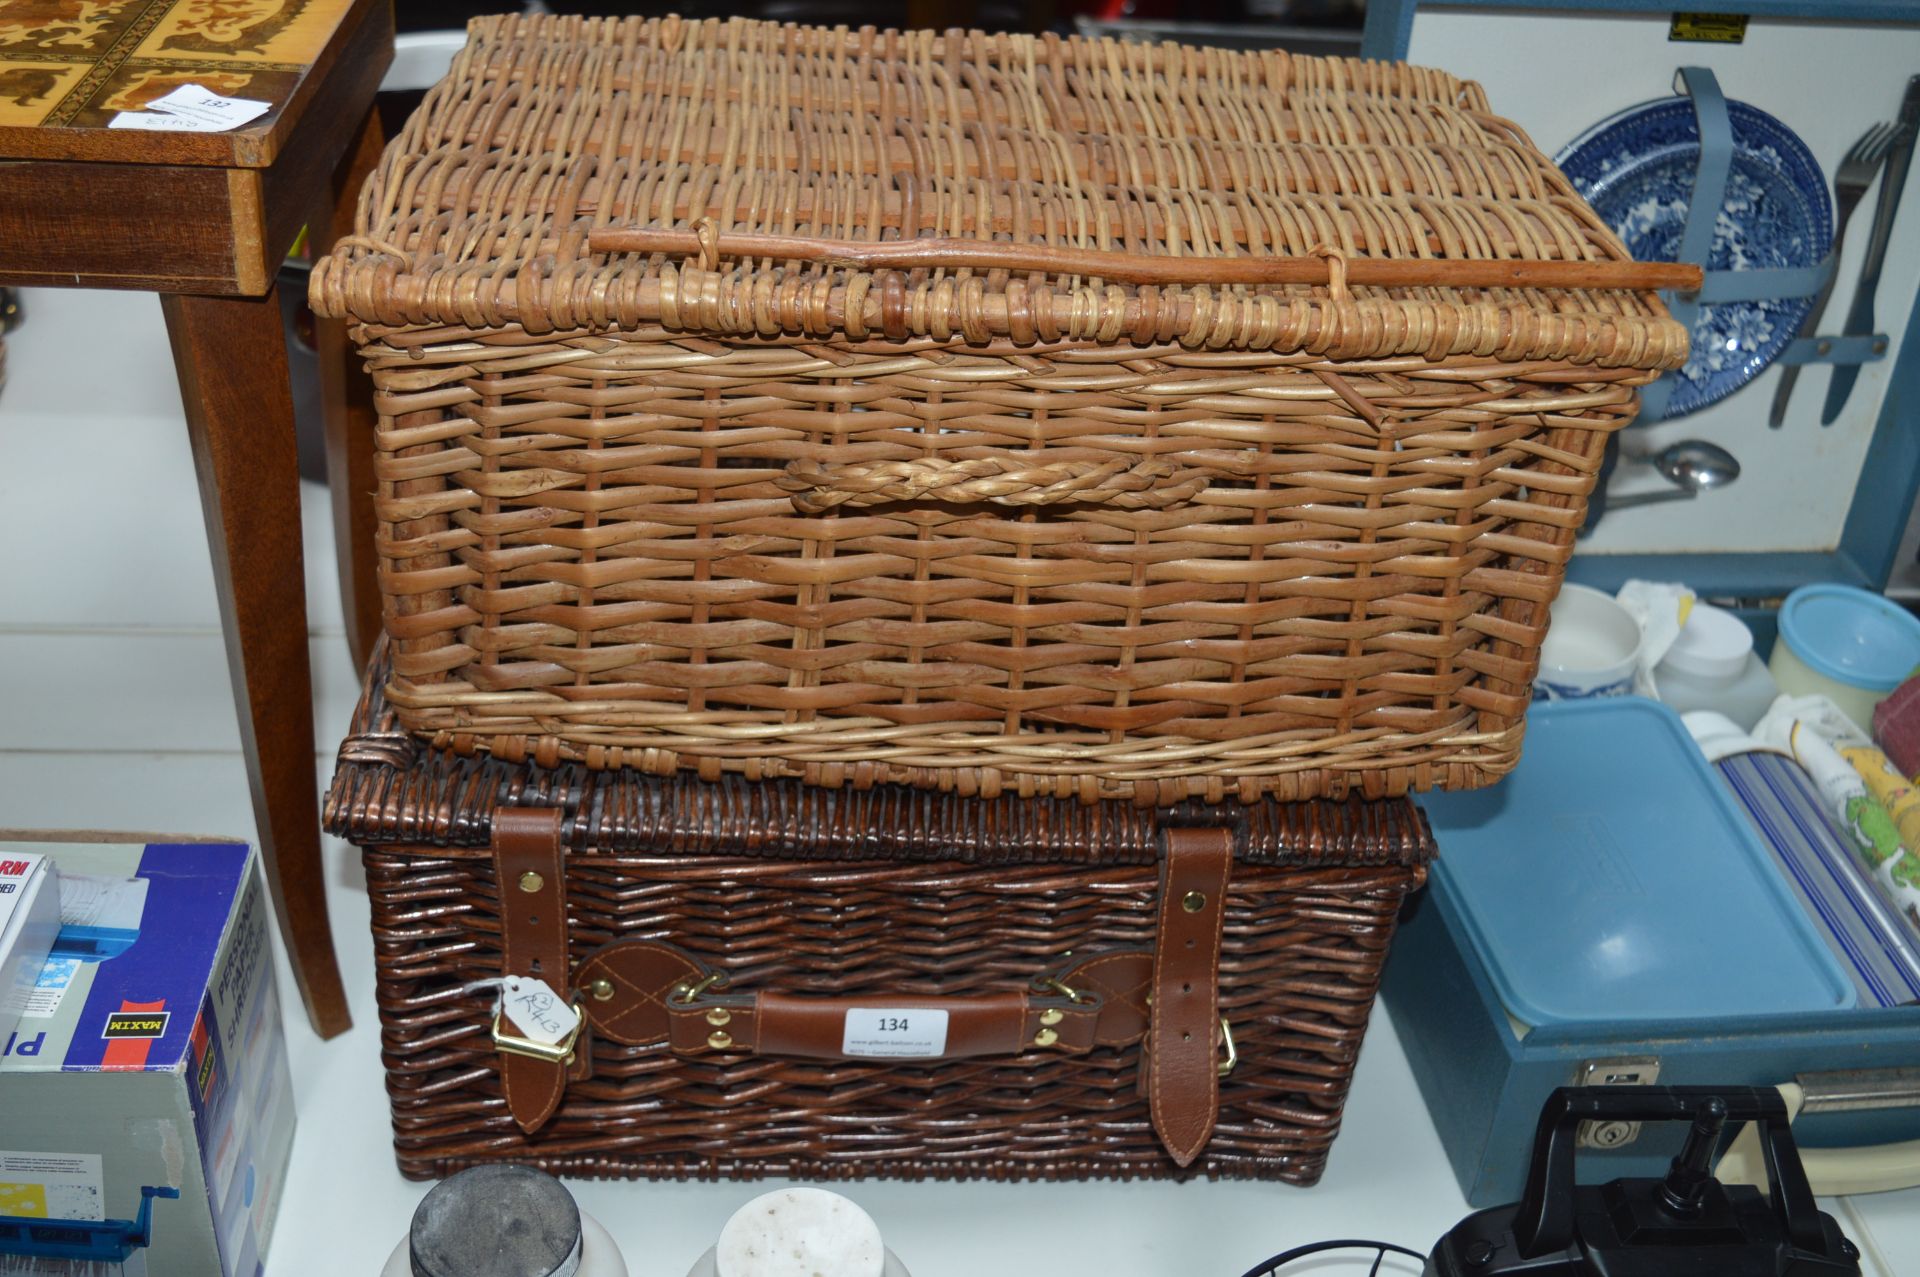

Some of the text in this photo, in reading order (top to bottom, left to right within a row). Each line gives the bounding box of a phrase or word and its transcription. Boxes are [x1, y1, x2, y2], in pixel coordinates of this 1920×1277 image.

[199, 99, 231, 109] 132
[218, 885, 259, 1007] PERSONAL
[230, 922, 255, 1000] PAPER
[227, 920, 264, 1049] SHREDDER
[110, 1021, 162, 1030] MAXIM
[877, 1018, 909, 1031] 134
